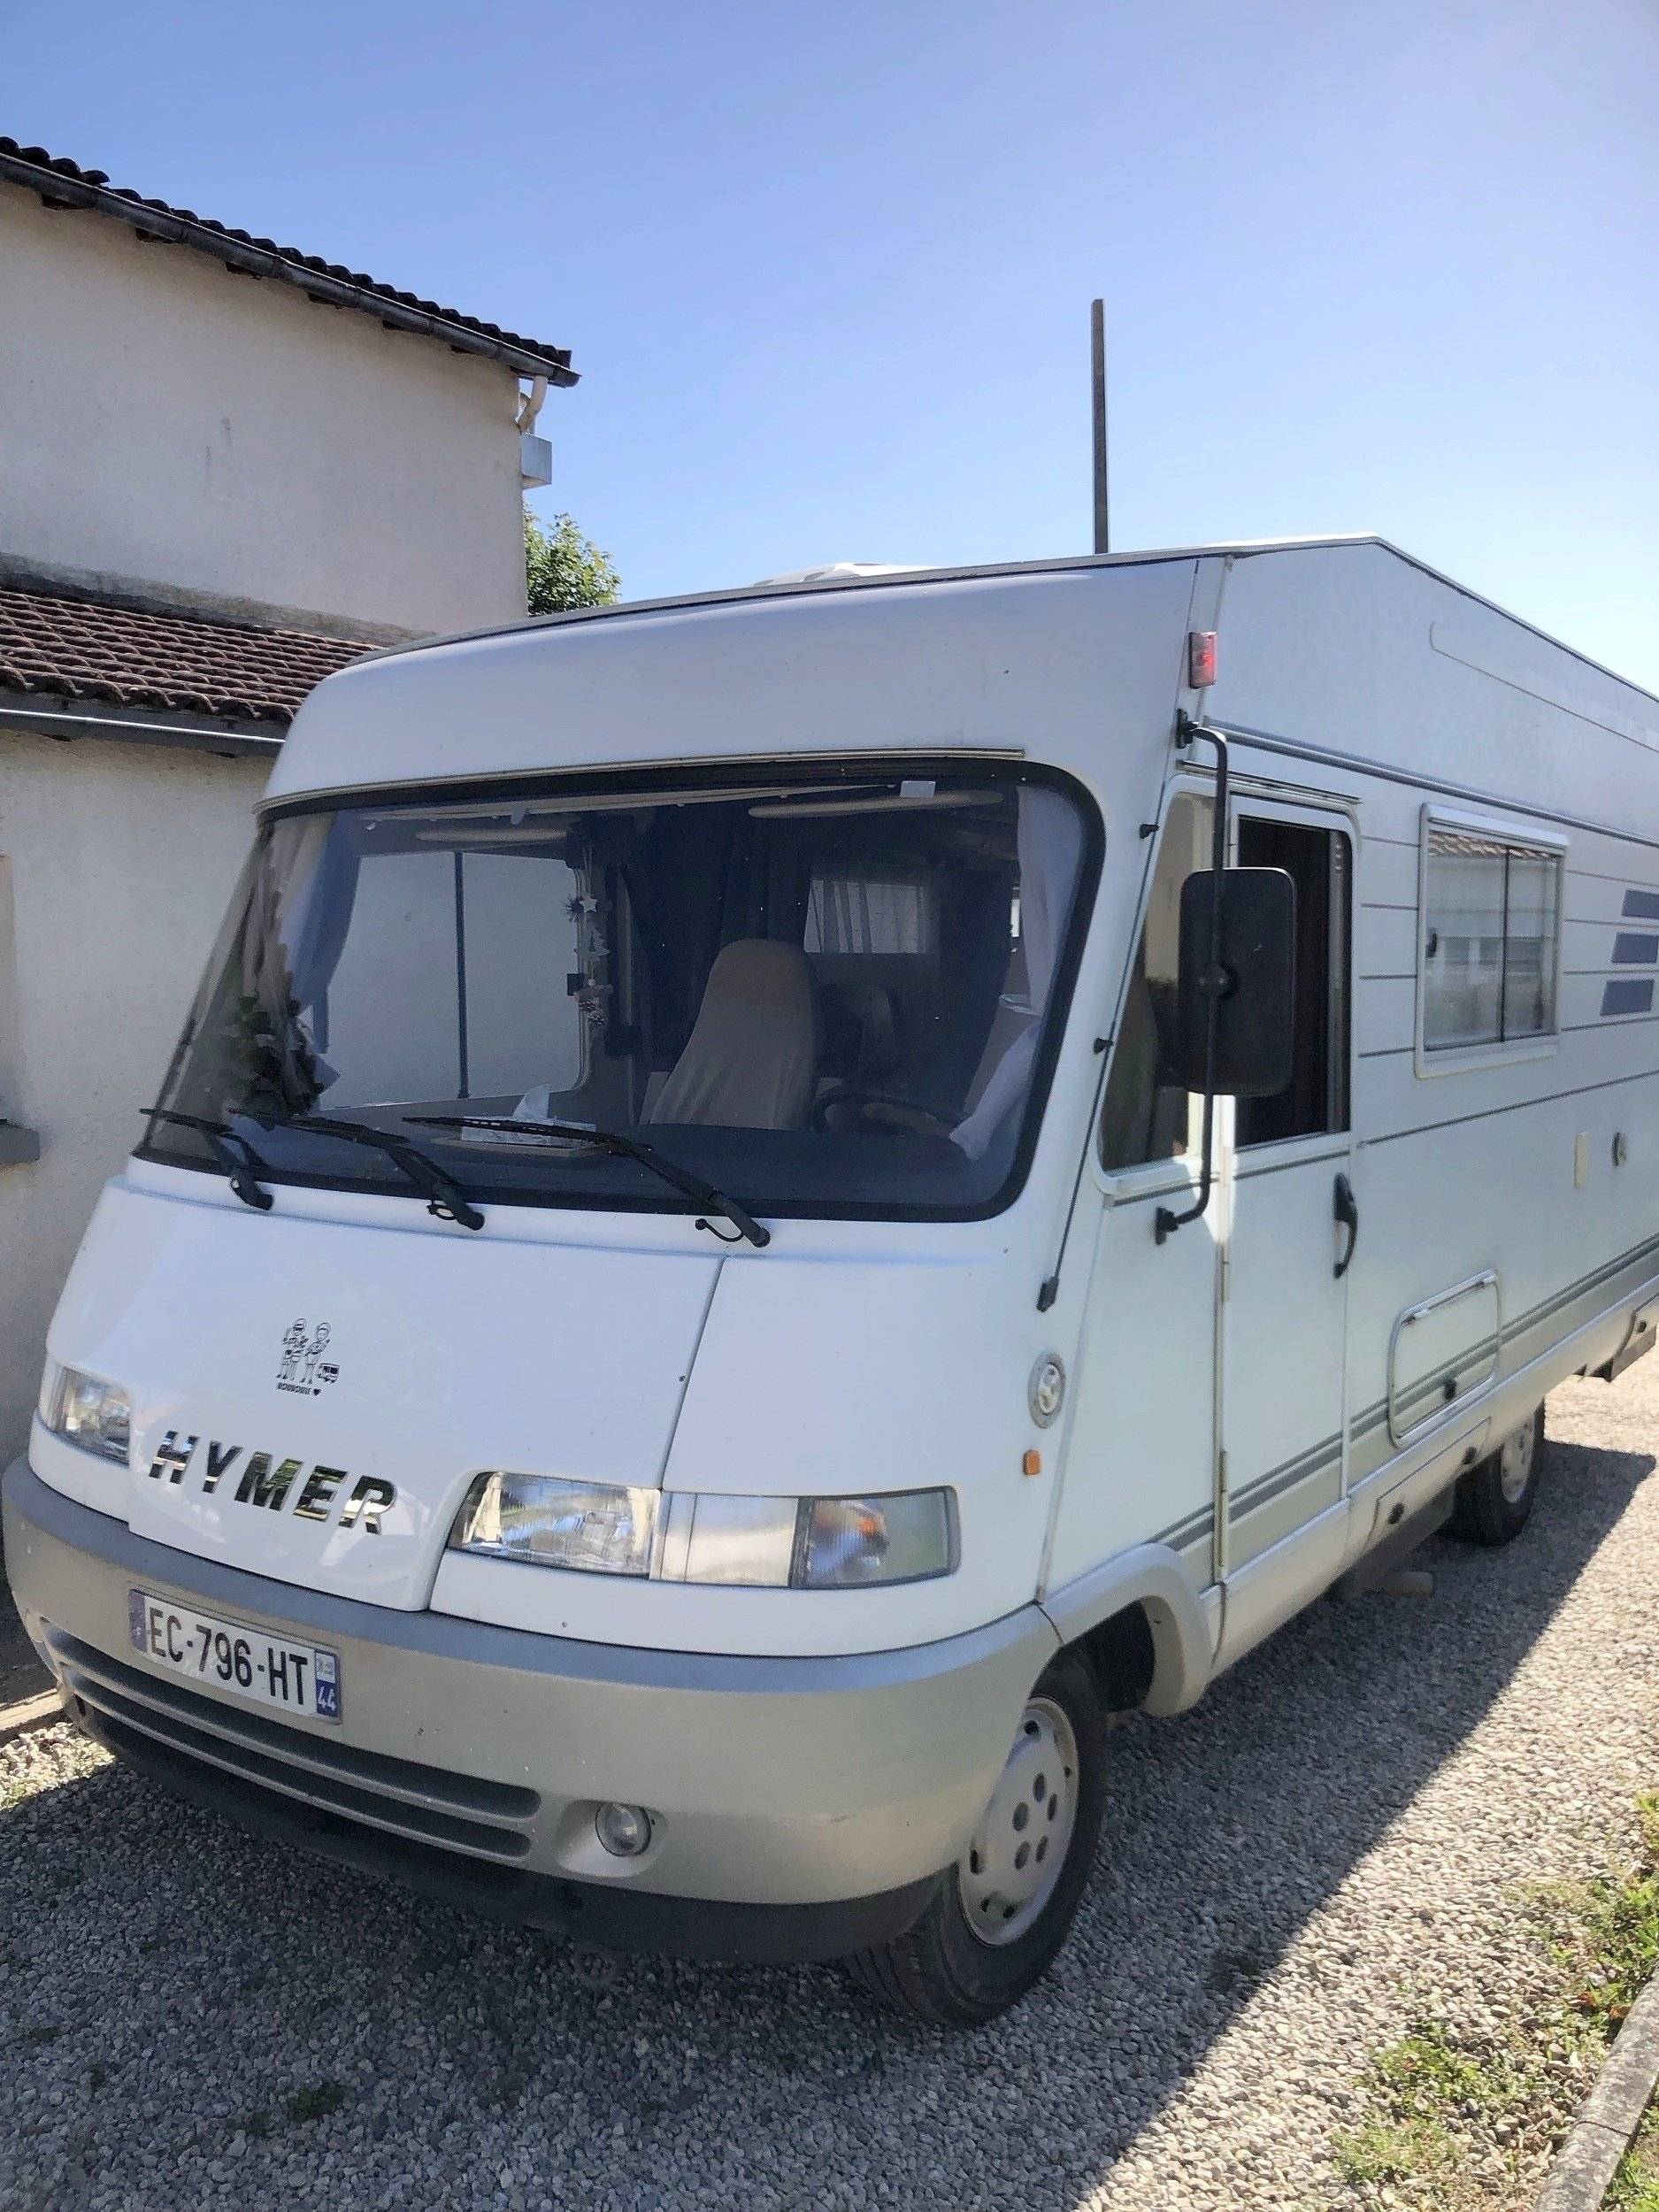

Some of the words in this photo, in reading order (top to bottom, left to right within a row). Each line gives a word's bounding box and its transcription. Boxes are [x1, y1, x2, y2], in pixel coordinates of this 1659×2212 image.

[149, 1430, 397, 1536] HYMER
[149, 1606, 308, 1706] EC-796-HT
[318, 1686, 336, 1712] 44
